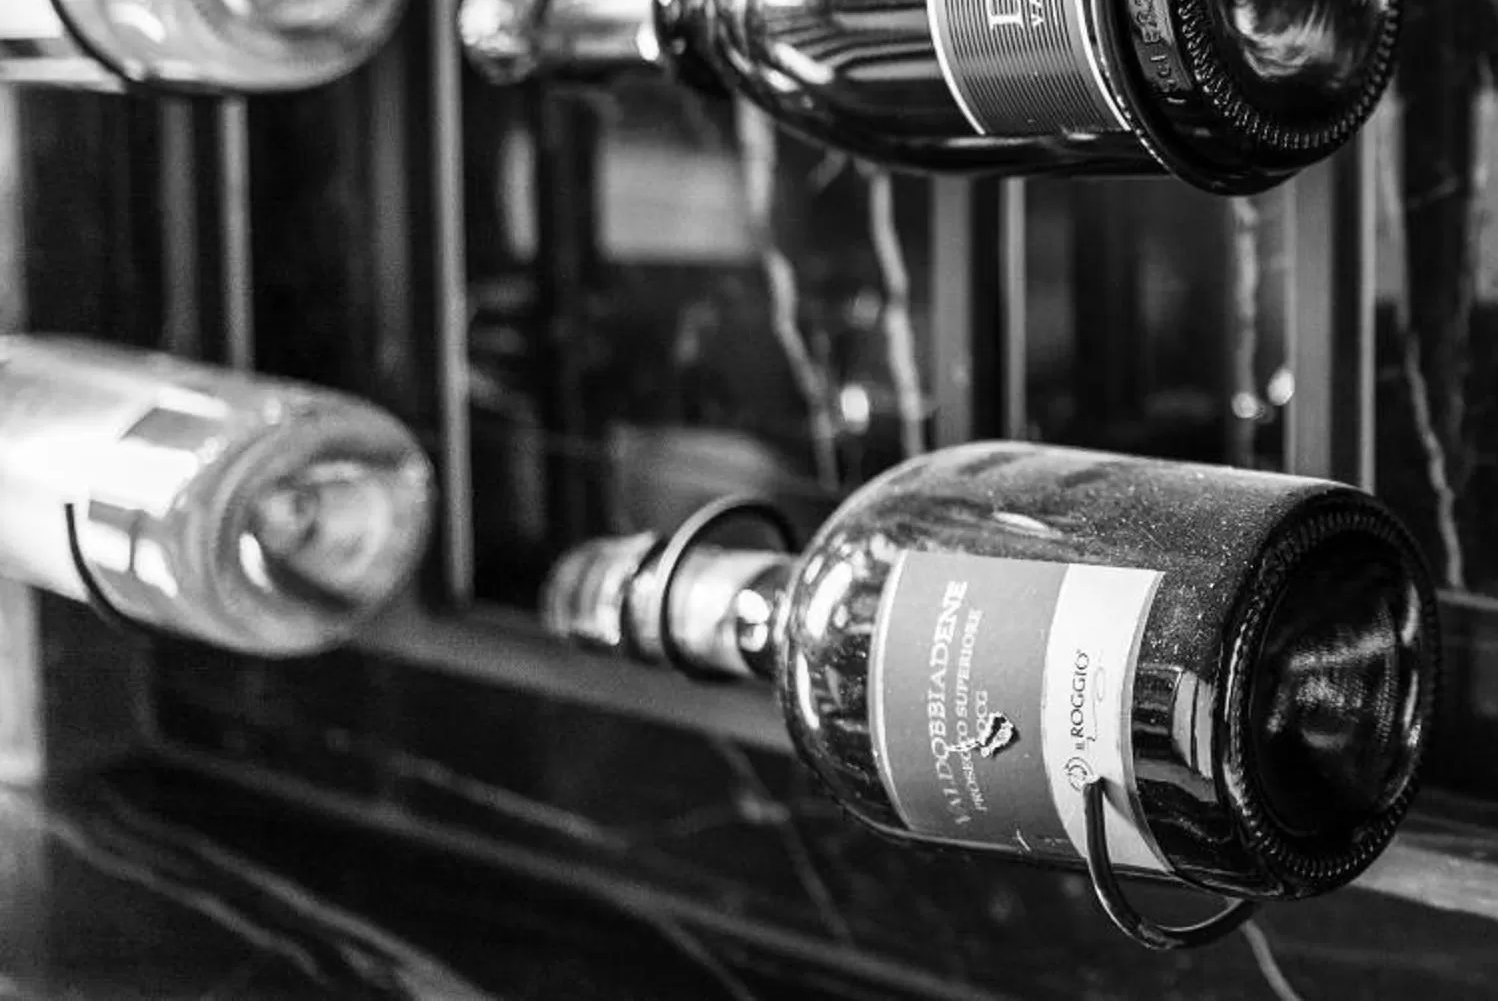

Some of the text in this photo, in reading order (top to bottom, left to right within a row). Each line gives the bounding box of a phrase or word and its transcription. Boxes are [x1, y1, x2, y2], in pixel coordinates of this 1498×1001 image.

[928, 581, 970, 825] VALDOBBIADENE
[955, 609, 983, 716] SUPERIORE
[1070, 651, 1090, 739] ROGGIO
[975, 690, 989, 737] OCG
